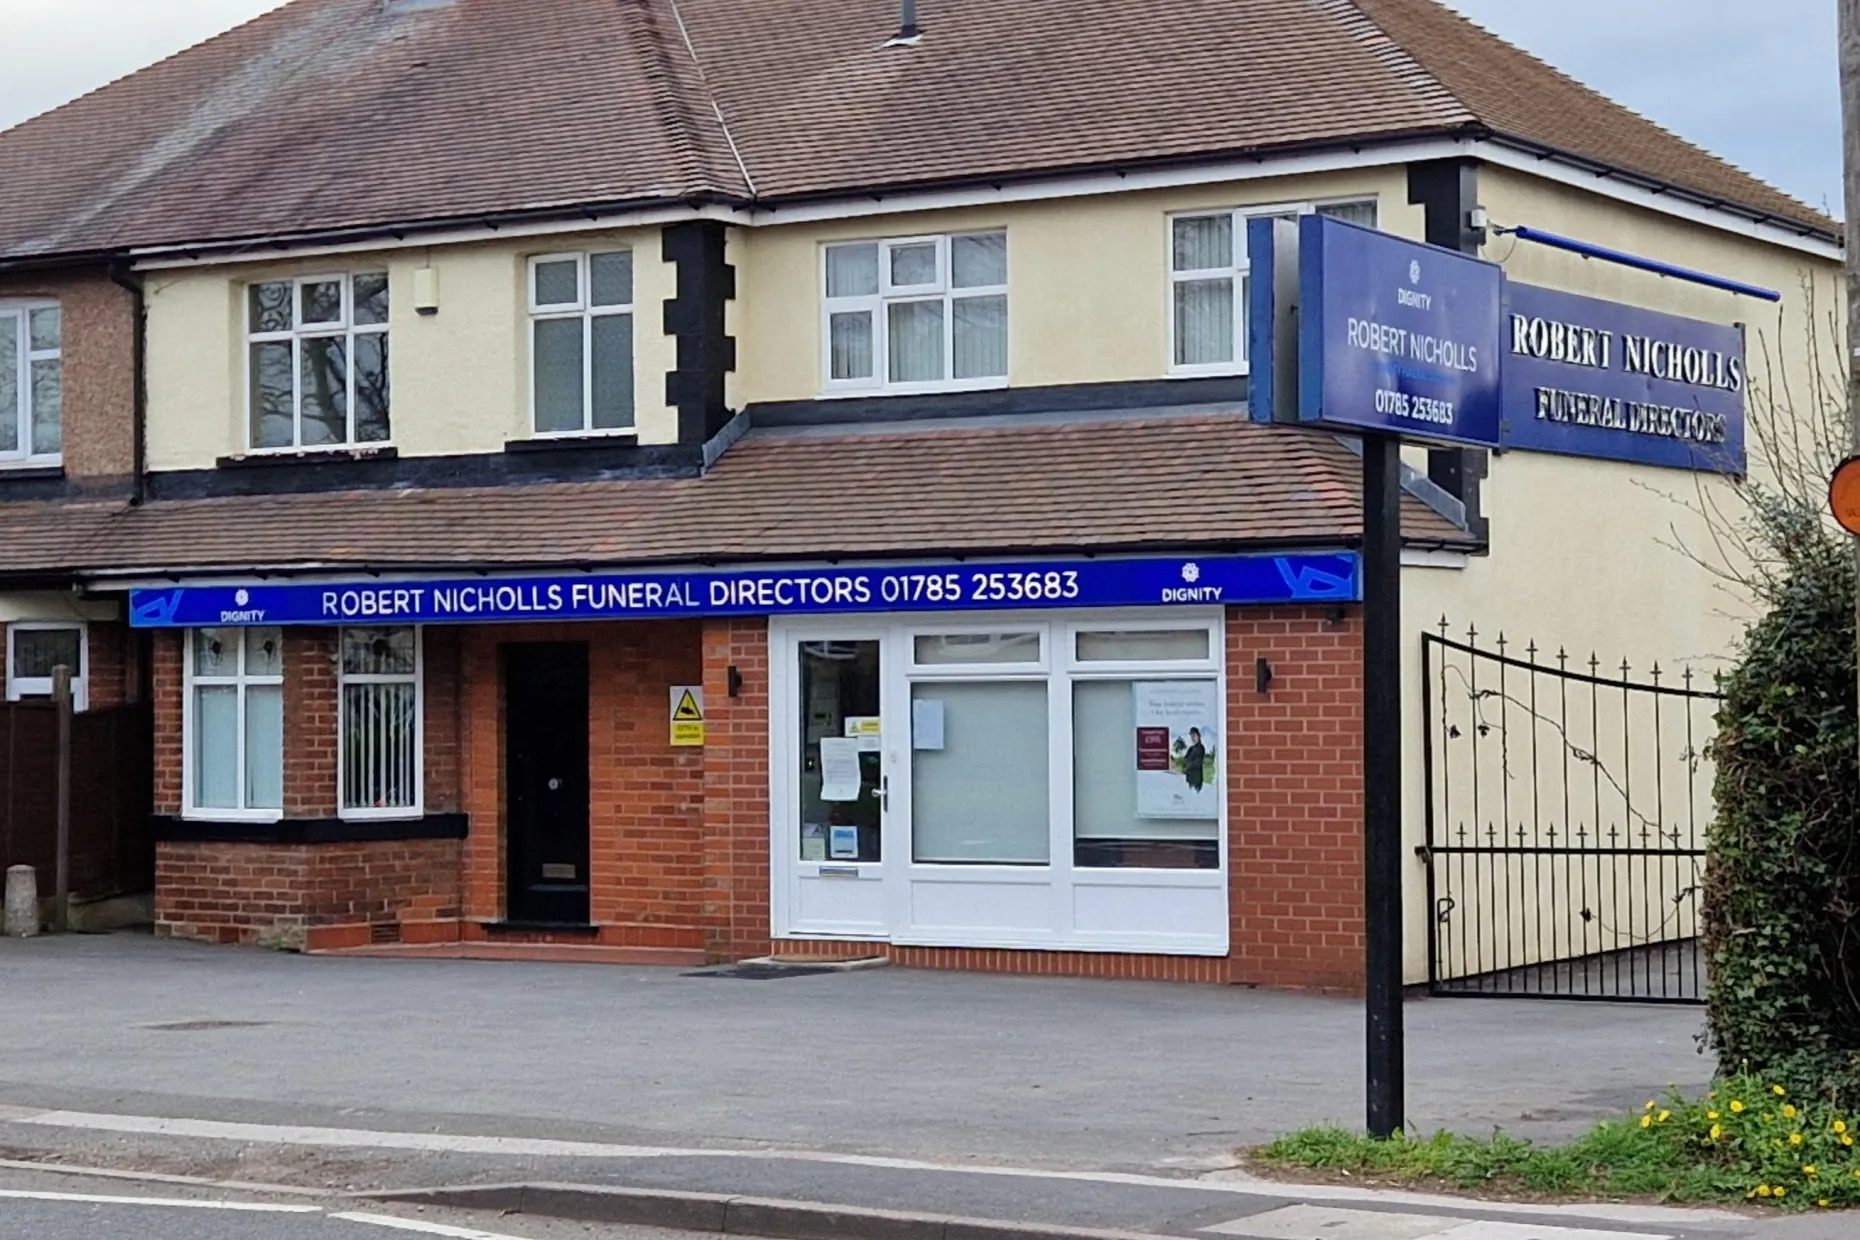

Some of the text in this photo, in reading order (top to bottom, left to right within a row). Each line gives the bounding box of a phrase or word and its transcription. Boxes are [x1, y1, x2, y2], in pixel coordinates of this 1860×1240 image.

[1398, 288, 1431, 310] DIGNITY
[1348, 317, 1406, 356] ROBERT
[1410, 332, 1477, 372] NICHOLLS
[1510, 313, 1741, 392] ROBERT NICHOLLS
[1375, 389, 1453, 425] 01785 253683
[1535, 386, 1727, 443] FUNERAL DIRECTORS
[322, 569, 1080, 616] ROBERT NICHOLLS FUNERAL DIRECTORS 01785 253683
[1162, 586, 1222, 602] DIGNITY
[220, 609, 264, 622] DIGNITY
